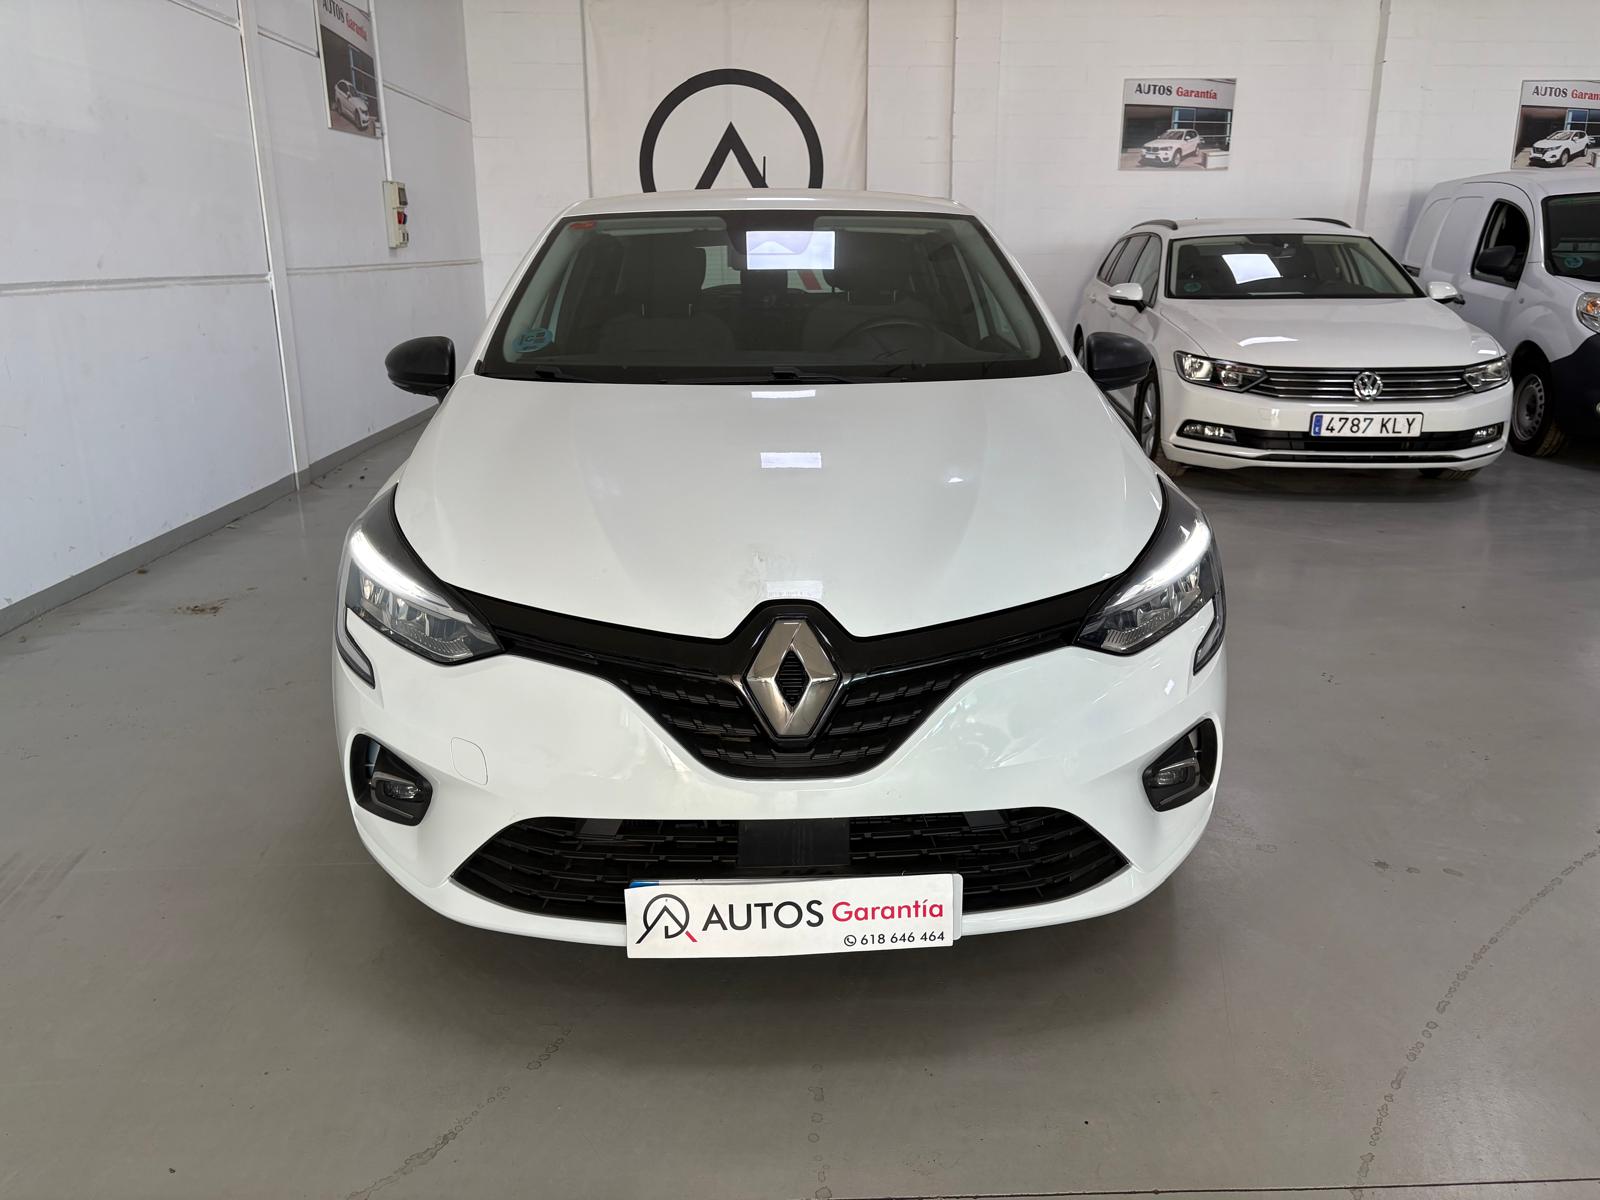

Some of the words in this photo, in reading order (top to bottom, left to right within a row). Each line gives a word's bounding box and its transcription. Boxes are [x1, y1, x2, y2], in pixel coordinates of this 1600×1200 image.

[323, 0, 344, 23] AUTOS
[1135, 83, 1173, 96] AUTOS
[1176, 86, 1217, 100] Garantía
[1532, 86, 1568, 98] AUTOS
[1571, 89, 1600, 100] Garan
[1325, 417, 1374, 434] 4787
[1379, 417, 1416, 434] KLY
[702, 900, 824, 931] AUTOS
[832, 899, 944, 922] Garantía
[860, 934, 886, 946] 618
[890, 932, 915, 944] 646
[920, 931, 945, 942] 464
